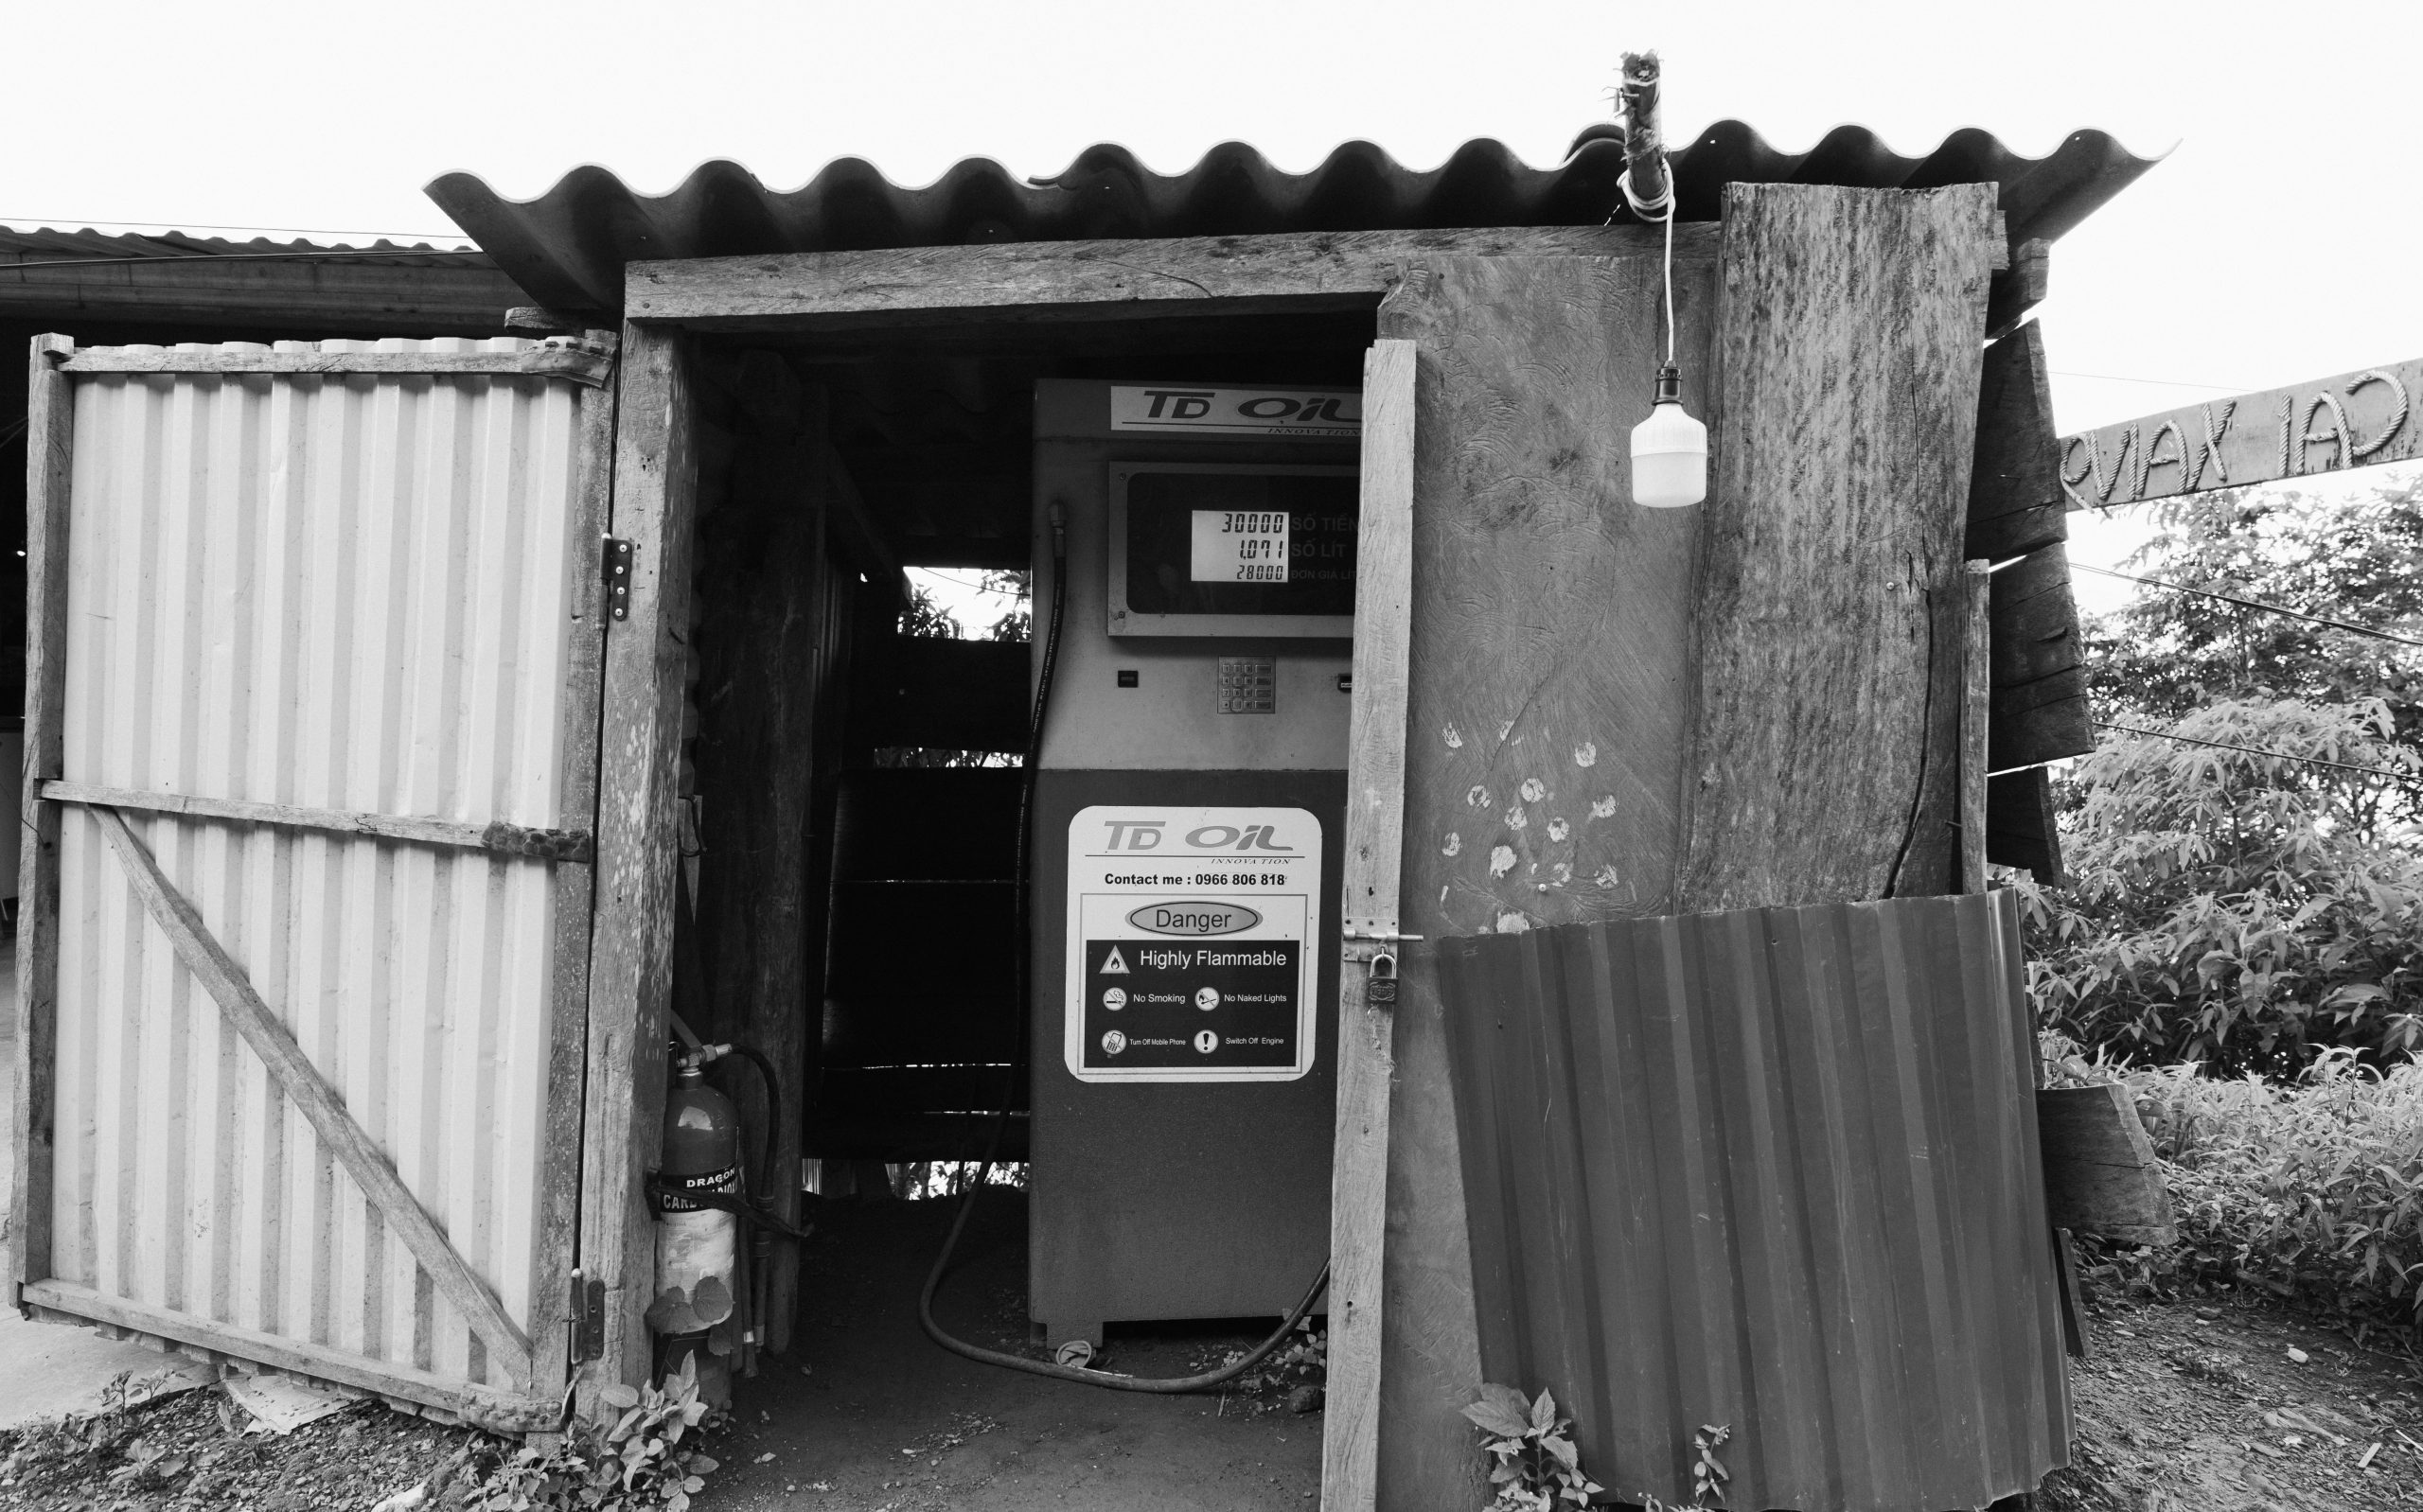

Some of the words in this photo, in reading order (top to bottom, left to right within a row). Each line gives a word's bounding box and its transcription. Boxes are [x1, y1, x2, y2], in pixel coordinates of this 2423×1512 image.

[1142, 390, 1216, 419] TD
[1222, 513, 1284, 534] 30000
[1240, 539, 1283, 560] 1.071
[1236, 565, 1283, 580] 28000
[1104, 820, 1166, 851] TD
[1105, 873, 1158, 885] Contact
[1162, 876, 1183, 885] me
[1194, 873, 1229, 886] 0966
[1232, 874, 1257, 886] 806
[1261, 874, 1284, 886] 818
[1156, 909, 1231, 932] Danger
[1141, 950, 1192, 970] Highly
[1197, 950, 1287, 966] Flammable
[1133, 994, 1147, 1003] No
[1148, 994, 1186, 1004] Smoking
[1265, 994, 1287, 1004] Lights
[1262, 1037, 1283, 1046] Engine
[686, 1167, 735, 1187] DRAGON
